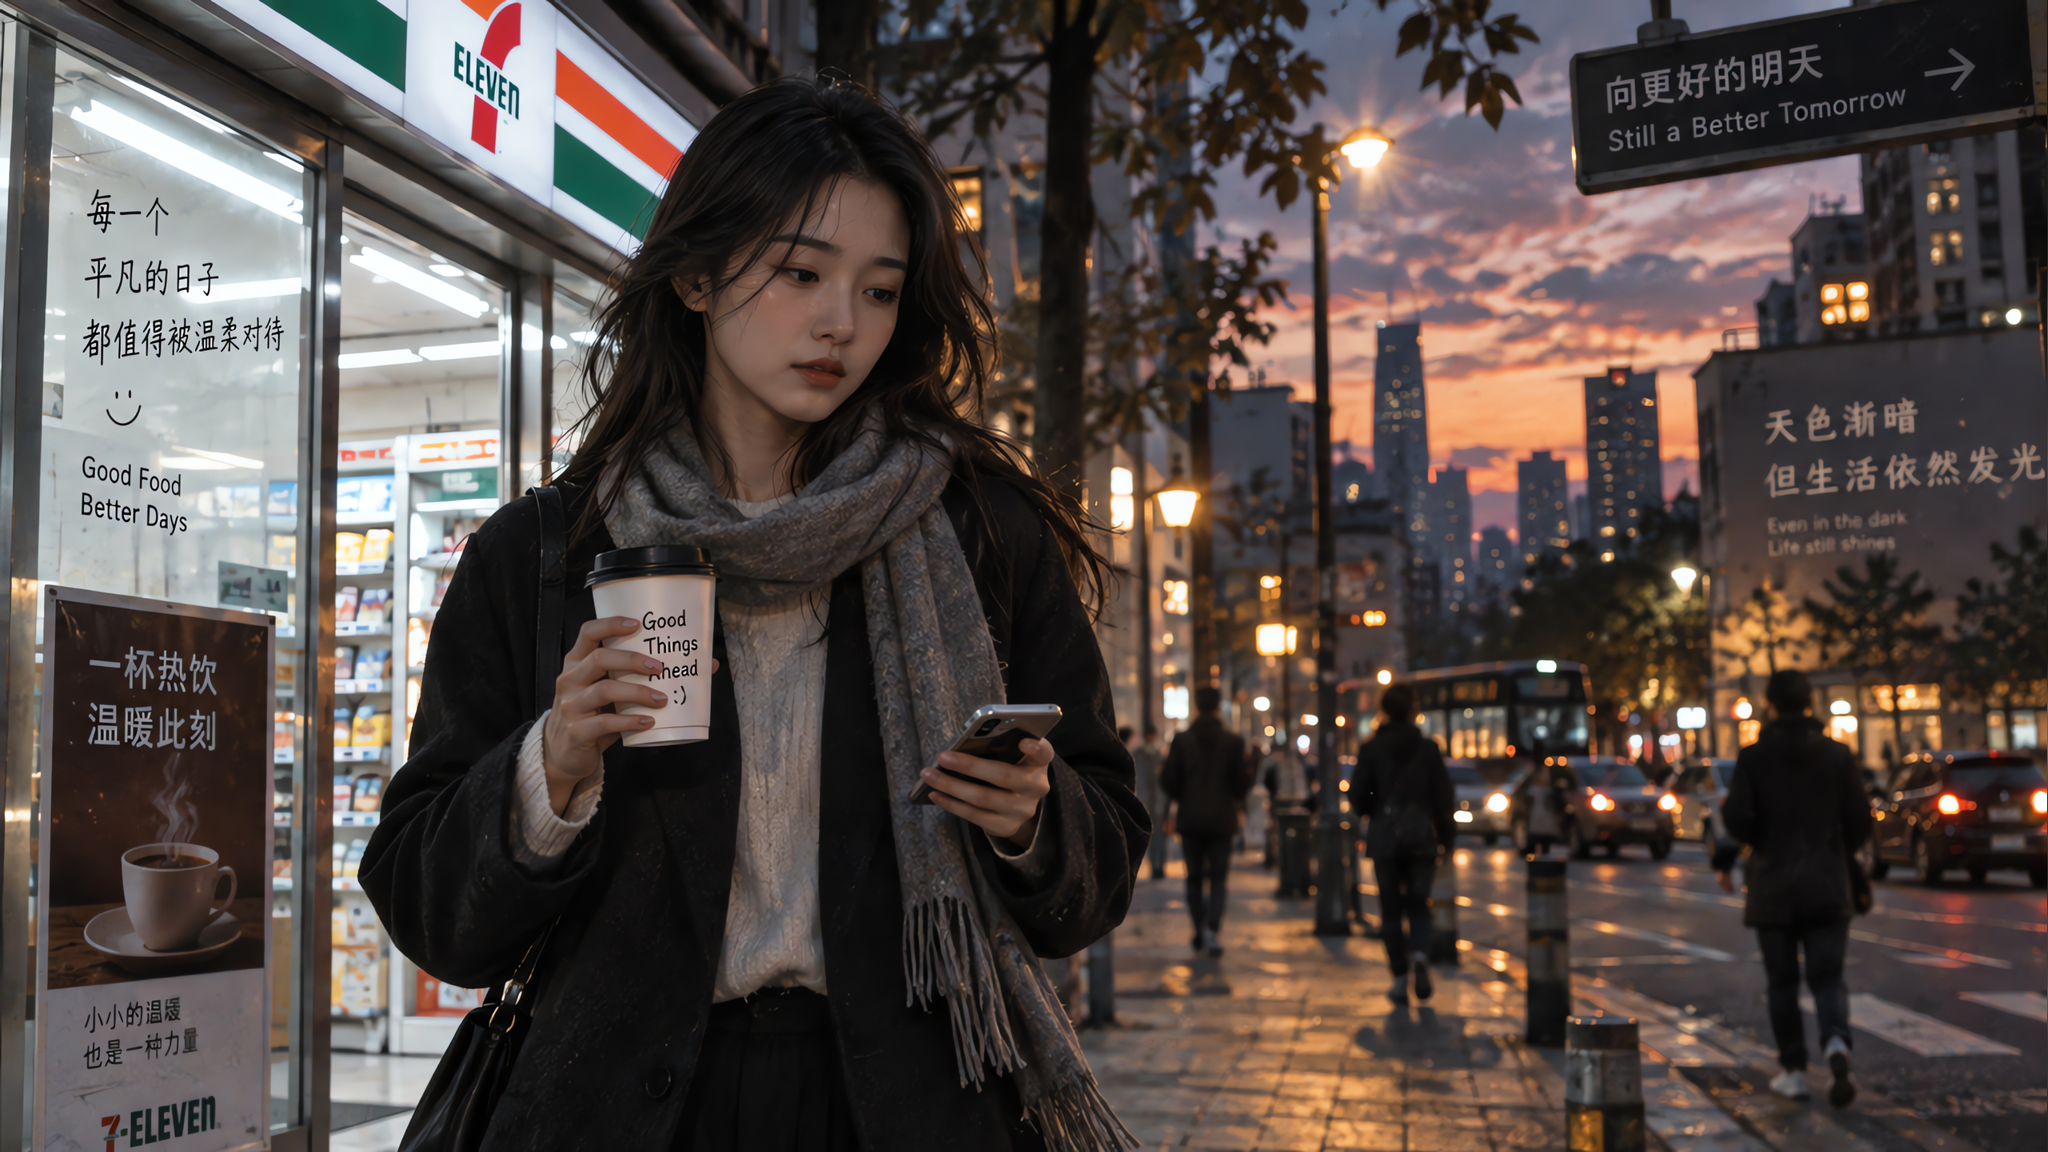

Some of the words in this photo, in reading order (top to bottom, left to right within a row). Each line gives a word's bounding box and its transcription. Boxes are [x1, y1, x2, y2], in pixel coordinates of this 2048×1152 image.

[1606, 44, 1823, 113] 向更好的明天
[1609, 124, 1656, 151] Still
[1667, 126, 1681, 142] a
[1692, 112, 1770, 138] Better
[1778, 89, 1906, 123] Tomorrow
[87, 189, 169, 236] 每一个
[85, 257, 219, 299] 平凡的日子
[82, 316, 285, 366] 都值得被温柔对待
[1764, 397, 1918, 446] 天色渐暗
[82, 456, 131, 486] Good
[139, 467, 181, 497] Food
[1764, 443, 2046, 498] 但生活依然发光
[81, 492, 140, 523] Better
[147, 504, 187, 536] Days
[1767, 516, 1808, 535] Even
[1813, 514, 1830, 531] in
[1834, 512, 1863, 530] the
[1868, 509, 1908, 528] dark
[1768, 538, 1801, 557] Life
[1805, 536, 1836, 555] still
[1841, 534, 1896, 553] shines
[642, 609, 686, 631] Good
[643, 635, 698, 657] Things
[89, 646, 217, 696] 一杯热饮
[88, 702, 216, 751] 温暖此刻
